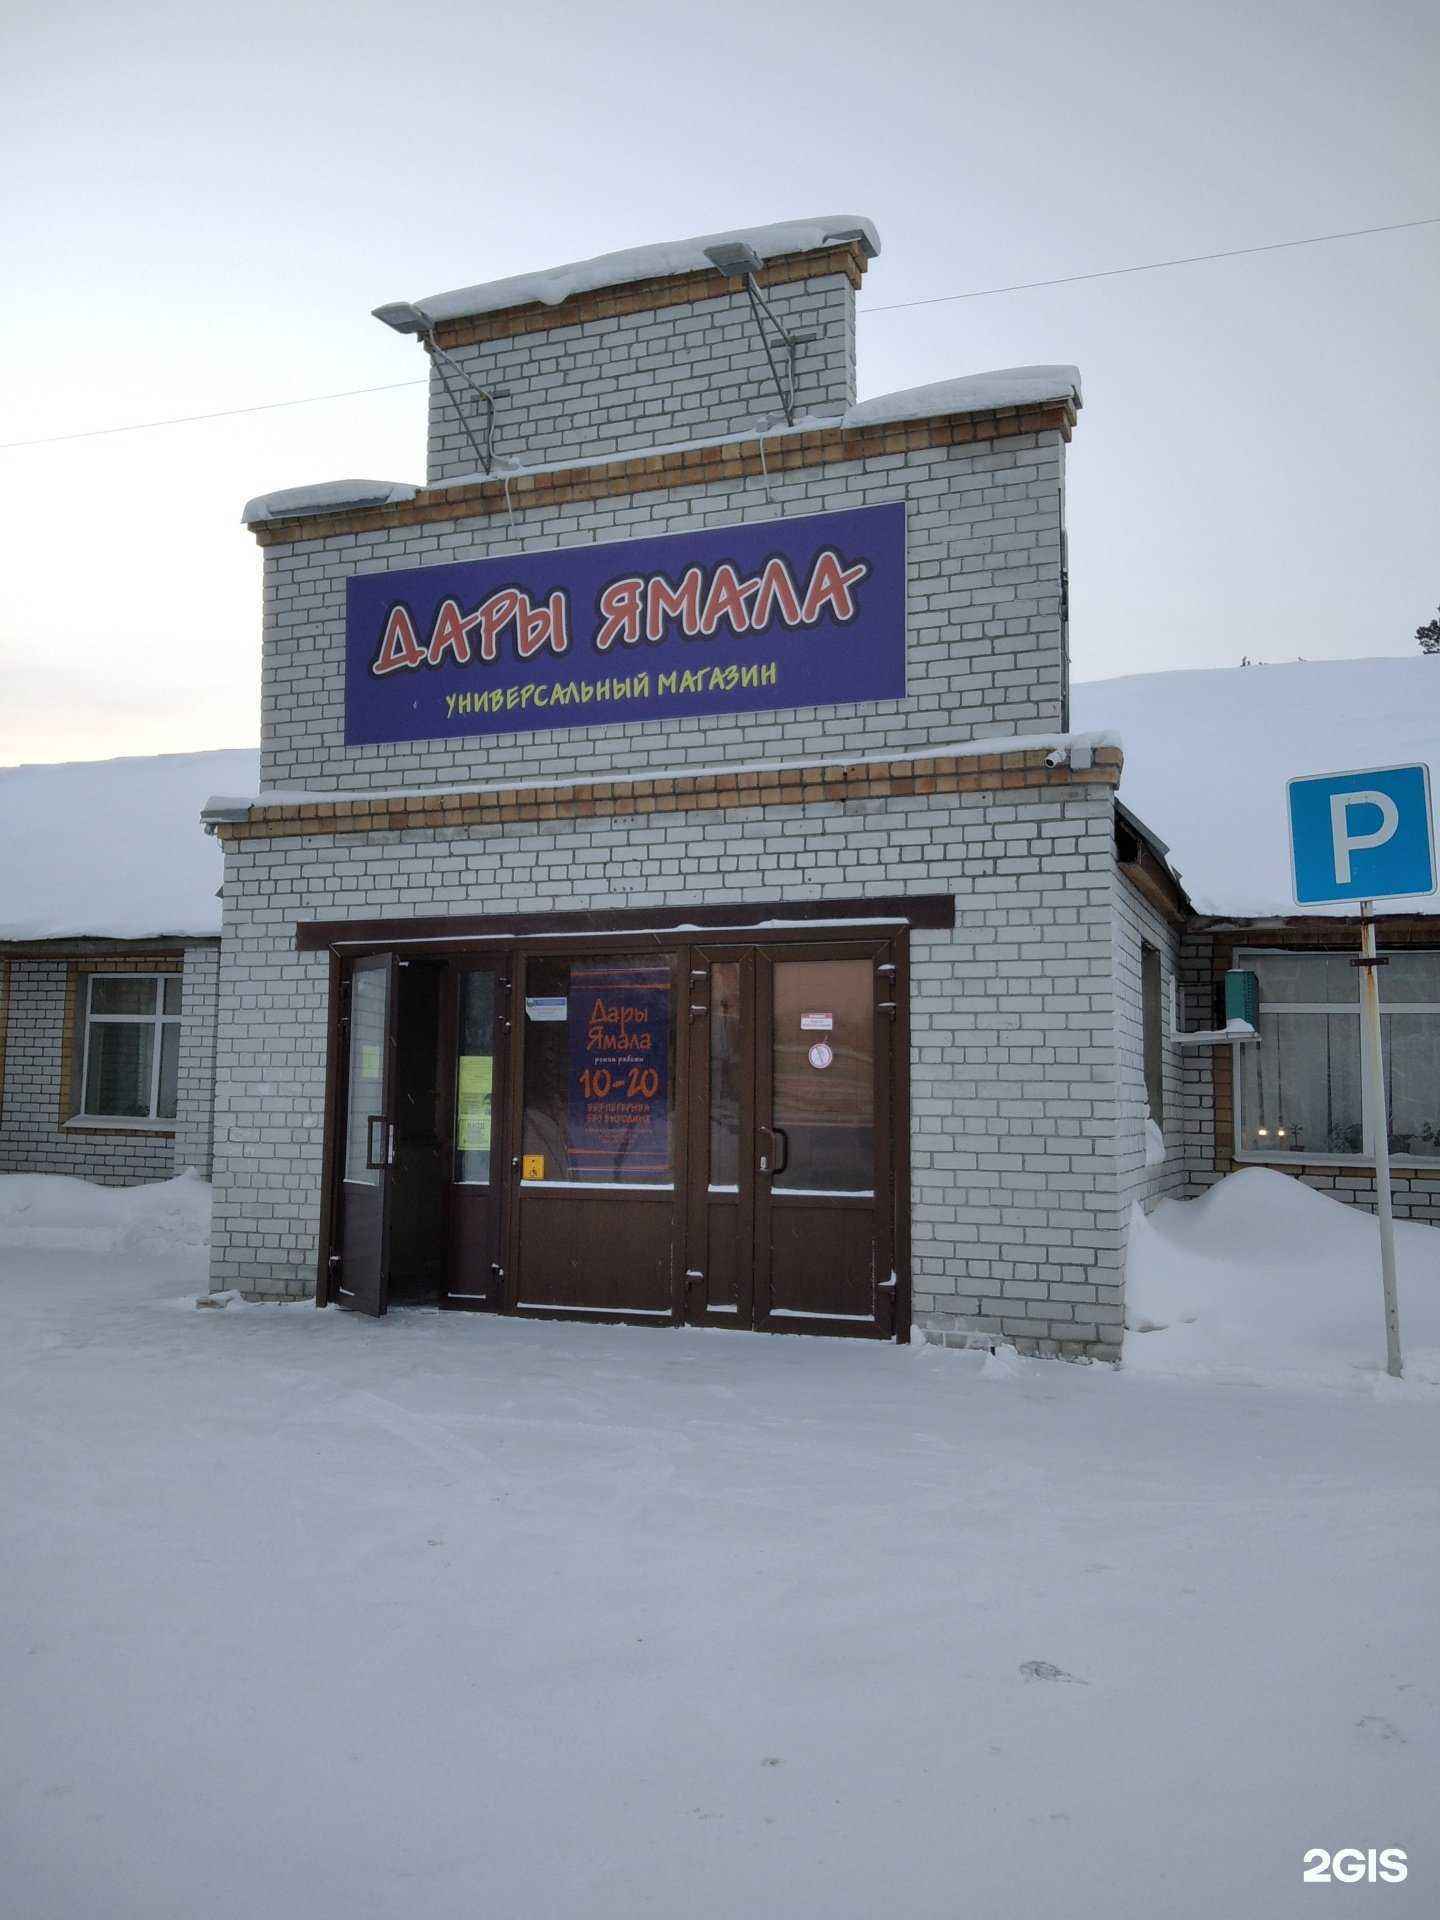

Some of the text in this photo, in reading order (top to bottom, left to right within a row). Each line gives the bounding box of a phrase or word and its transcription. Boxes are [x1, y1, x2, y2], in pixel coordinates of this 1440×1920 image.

[372, 551, 867, 676] ДАРЫ ЯМАЛА
[445, 662, 777, 718] УНИВЕРСАЛЬНЫЙ МАГАЗИН
[1330, 790, 1399, 884] P
[586, 1024, 652, 1050] Ямала
[589, 998, 648, 1031] Дары
